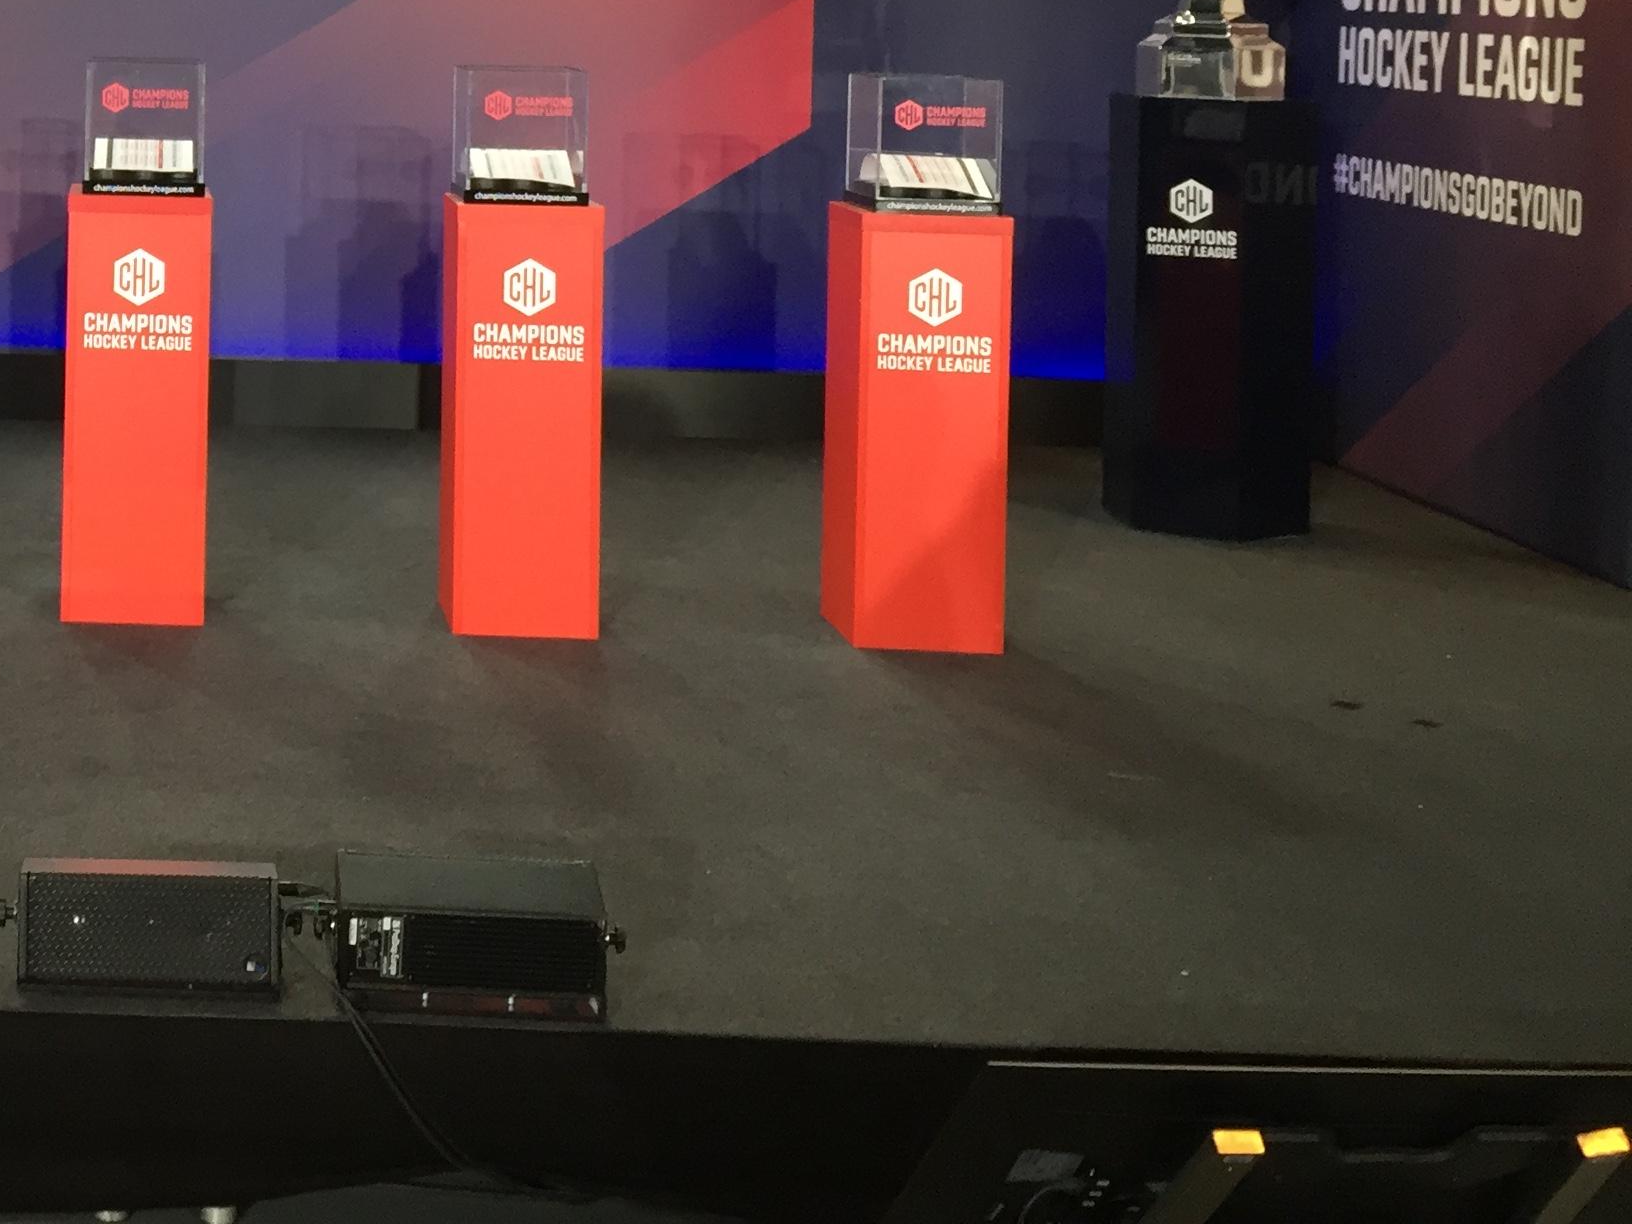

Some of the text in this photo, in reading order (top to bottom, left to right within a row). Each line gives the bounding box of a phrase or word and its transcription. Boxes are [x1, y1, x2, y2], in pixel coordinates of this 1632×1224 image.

[1338, 25, 1586, 108] HOCKEY LEAGUE
[132, 88, 190, 100] CHAMPIONS
[897, 104, 921, 126] CHL
[1174, 185, 1209, 217] CHL
[1332, 152, 1584, 236] #CHAMPIONSGOBEYOND
[1146, 227, 1238, 247] CHAMPIONS
[1146, 243, 1238, 260] HOCKEY LEAGUE
[119, 257, 160, 297] CHL
[509, 268, 551, 307] CHL
[914, 278, 957, 317] CHL
[83, 311, 193, 335] CHAMPIONS
[473, 322, 585, 345] CHAMPIONS
[83, 334, 192, 351] HOCKEY LEAGUE
[473, 344, 584, 362] HOCKEY LEAGUE
[877, 333, 993, 356] CHAMPIONS
[877, 355, 992, 374] HOCKEY LEAGUE
